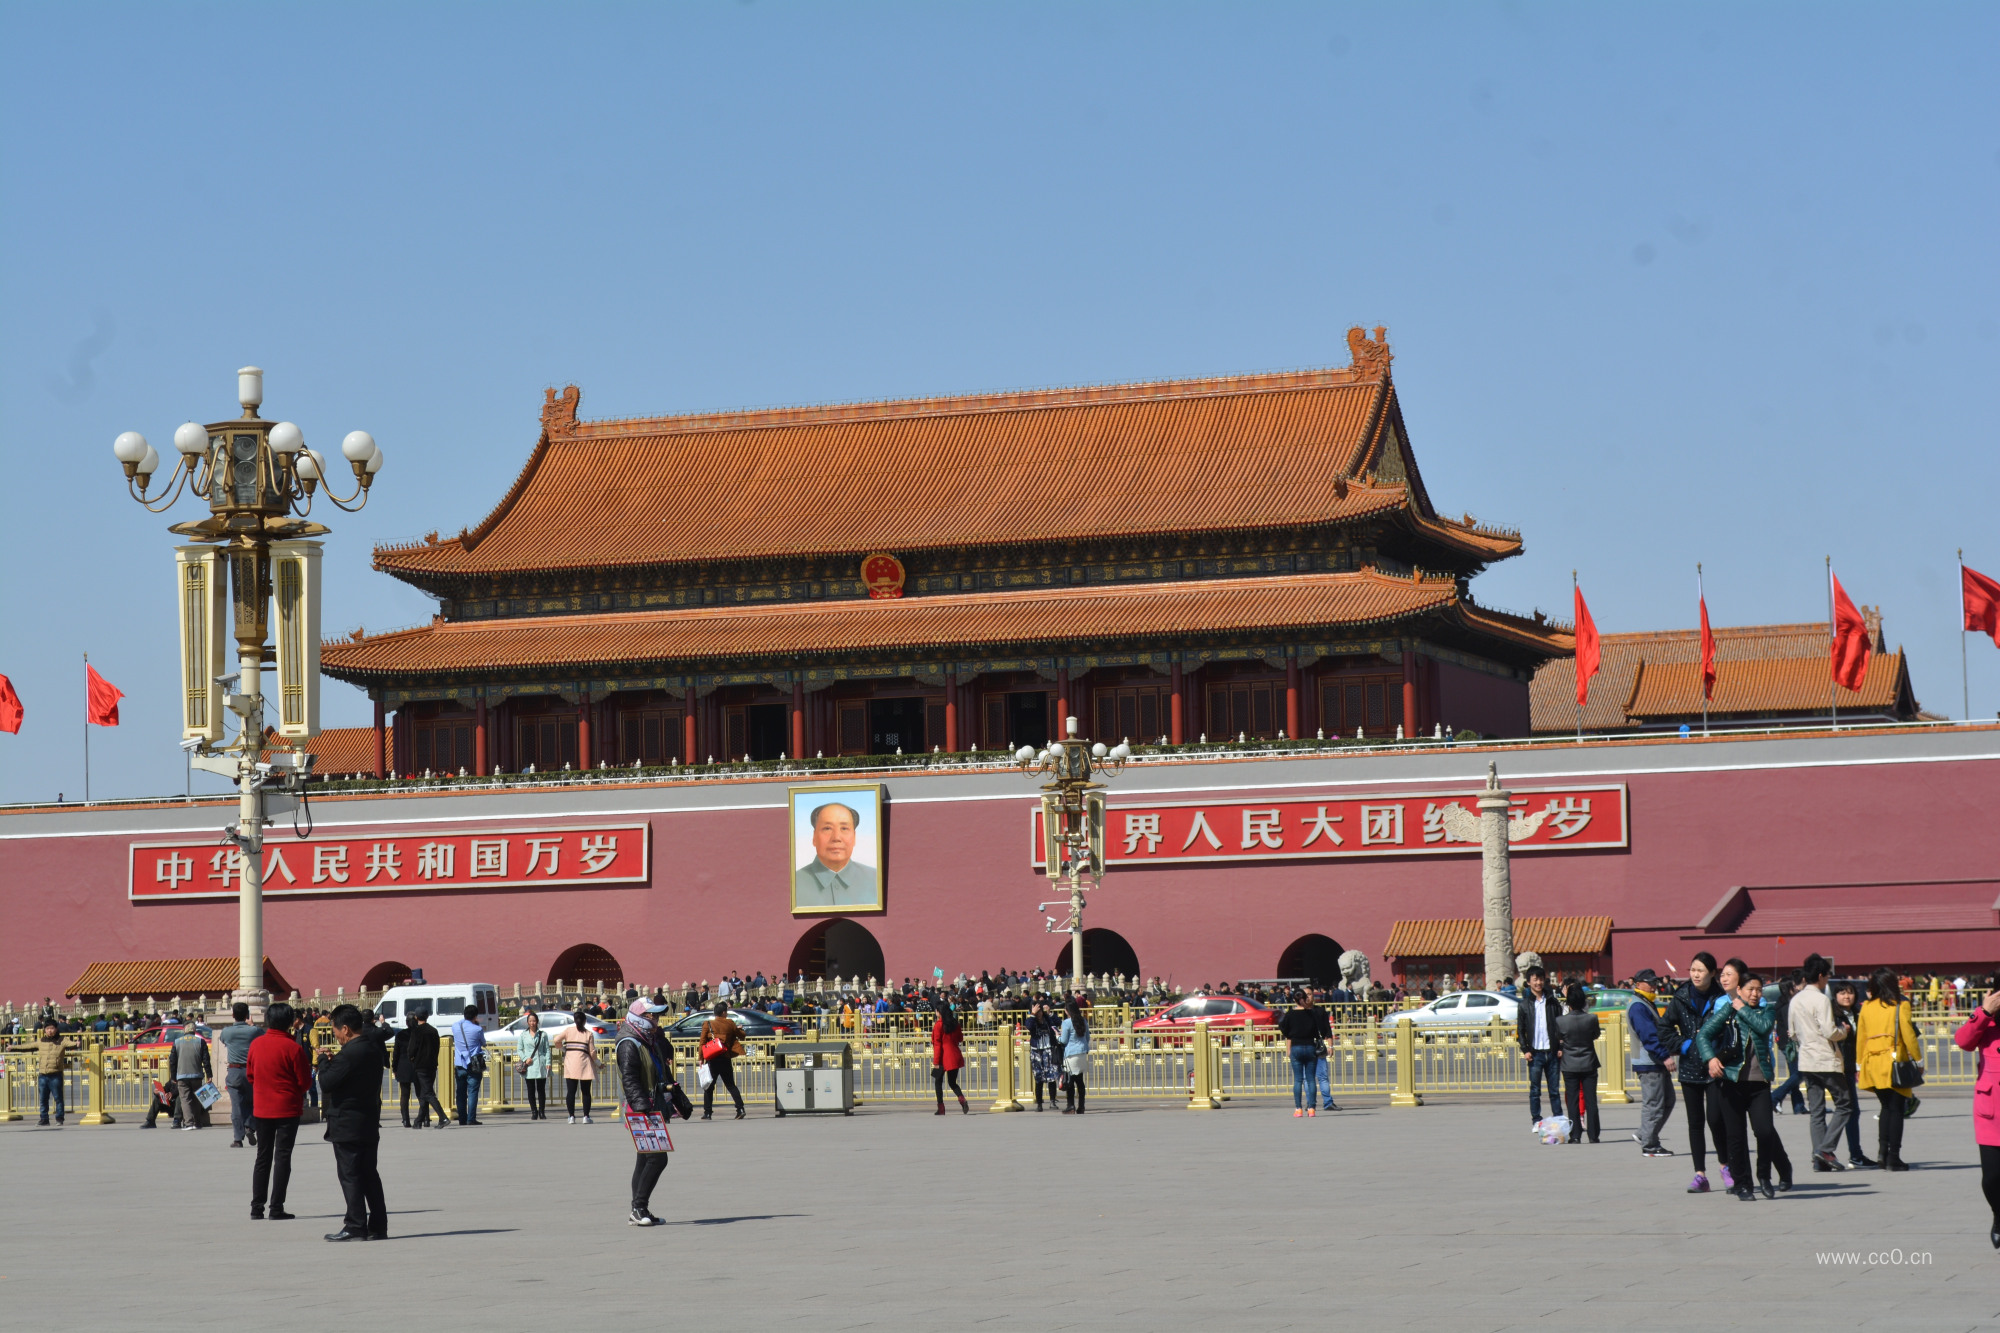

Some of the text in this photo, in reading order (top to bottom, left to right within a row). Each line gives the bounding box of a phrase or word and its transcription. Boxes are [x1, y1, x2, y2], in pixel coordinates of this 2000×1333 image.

[1063, 796, 1593, 857] 界人民大团结岁
[156, 834, 619, 890] 中华人民共和国万岁
